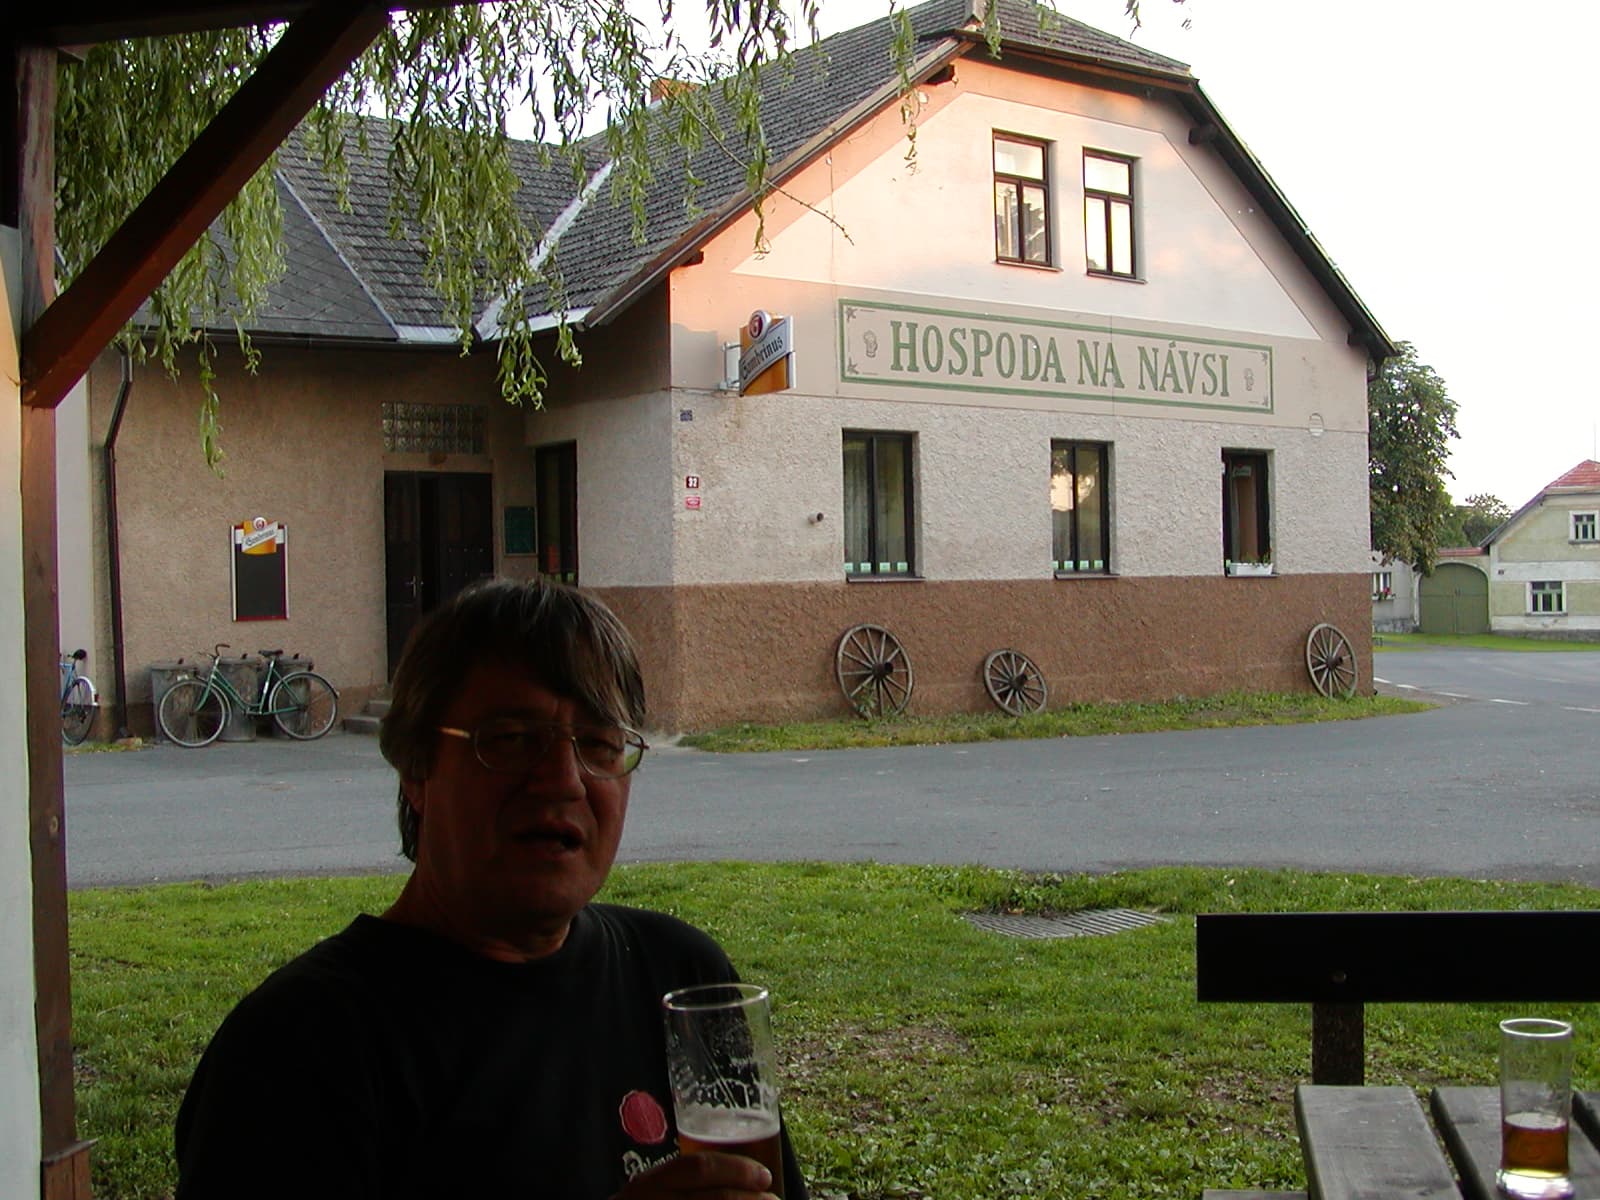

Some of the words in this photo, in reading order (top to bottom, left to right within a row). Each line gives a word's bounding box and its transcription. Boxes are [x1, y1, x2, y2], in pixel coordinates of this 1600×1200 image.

[890, 320, 1066, 383] HOSPODA
[1077, 339, 1124, 389] NA
[1137, 340, 1230, 397] NÁVSI
